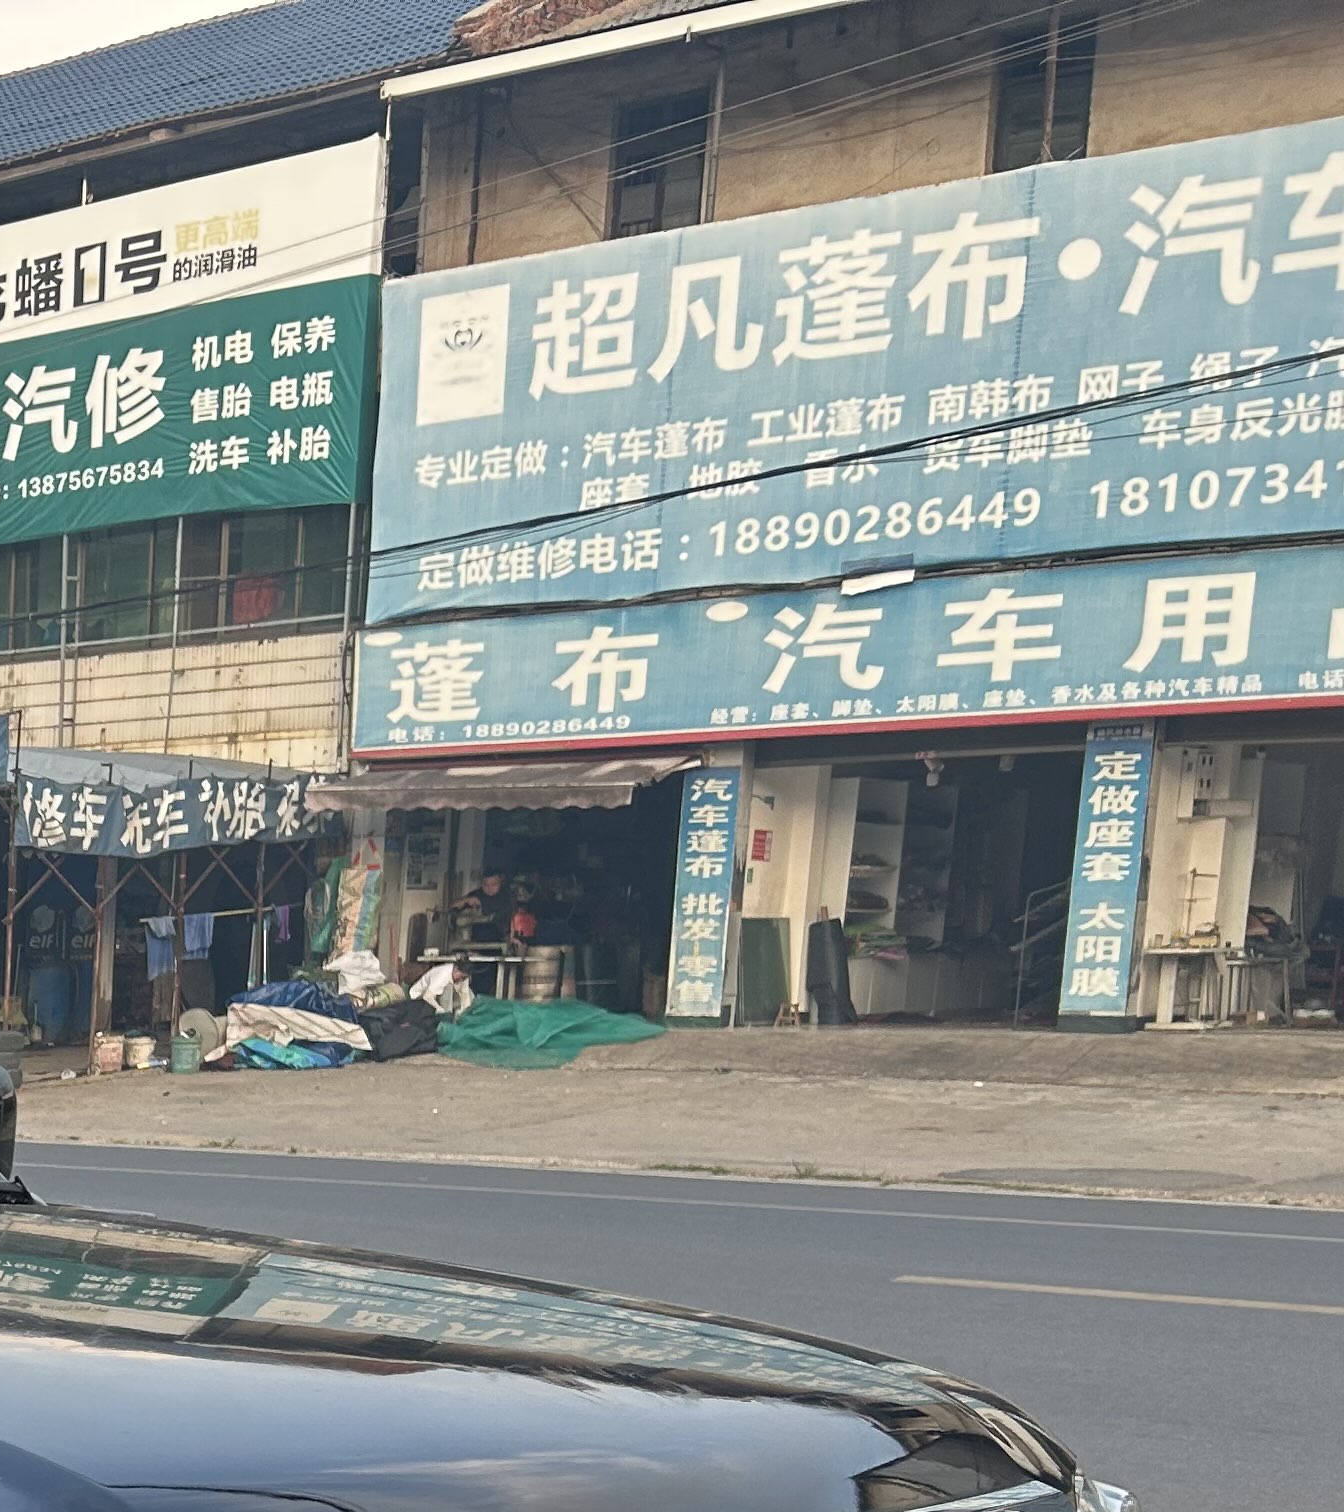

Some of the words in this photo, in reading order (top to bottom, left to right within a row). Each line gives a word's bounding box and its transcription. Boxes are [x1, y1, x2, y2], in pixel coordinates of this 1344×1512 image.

[173, 208, 261, 256] 更高端
[172, 244, 259, 284] 的润滑油
[191, 329, 253, 372] 机电
[270, 316, 337, 360] 保养
[191, 382, 252, 424] 售胎
[269, 370, 334, 410] 电瓶
[188, 433, 250, 475] 洗车
[266, 424, 332, 466] 补胎
[763, 571, 1344, 694] 汽车用
[1081, 751, 1142, 882] 定做座套
[1069, 902, 1126, 997] 太阳膜
